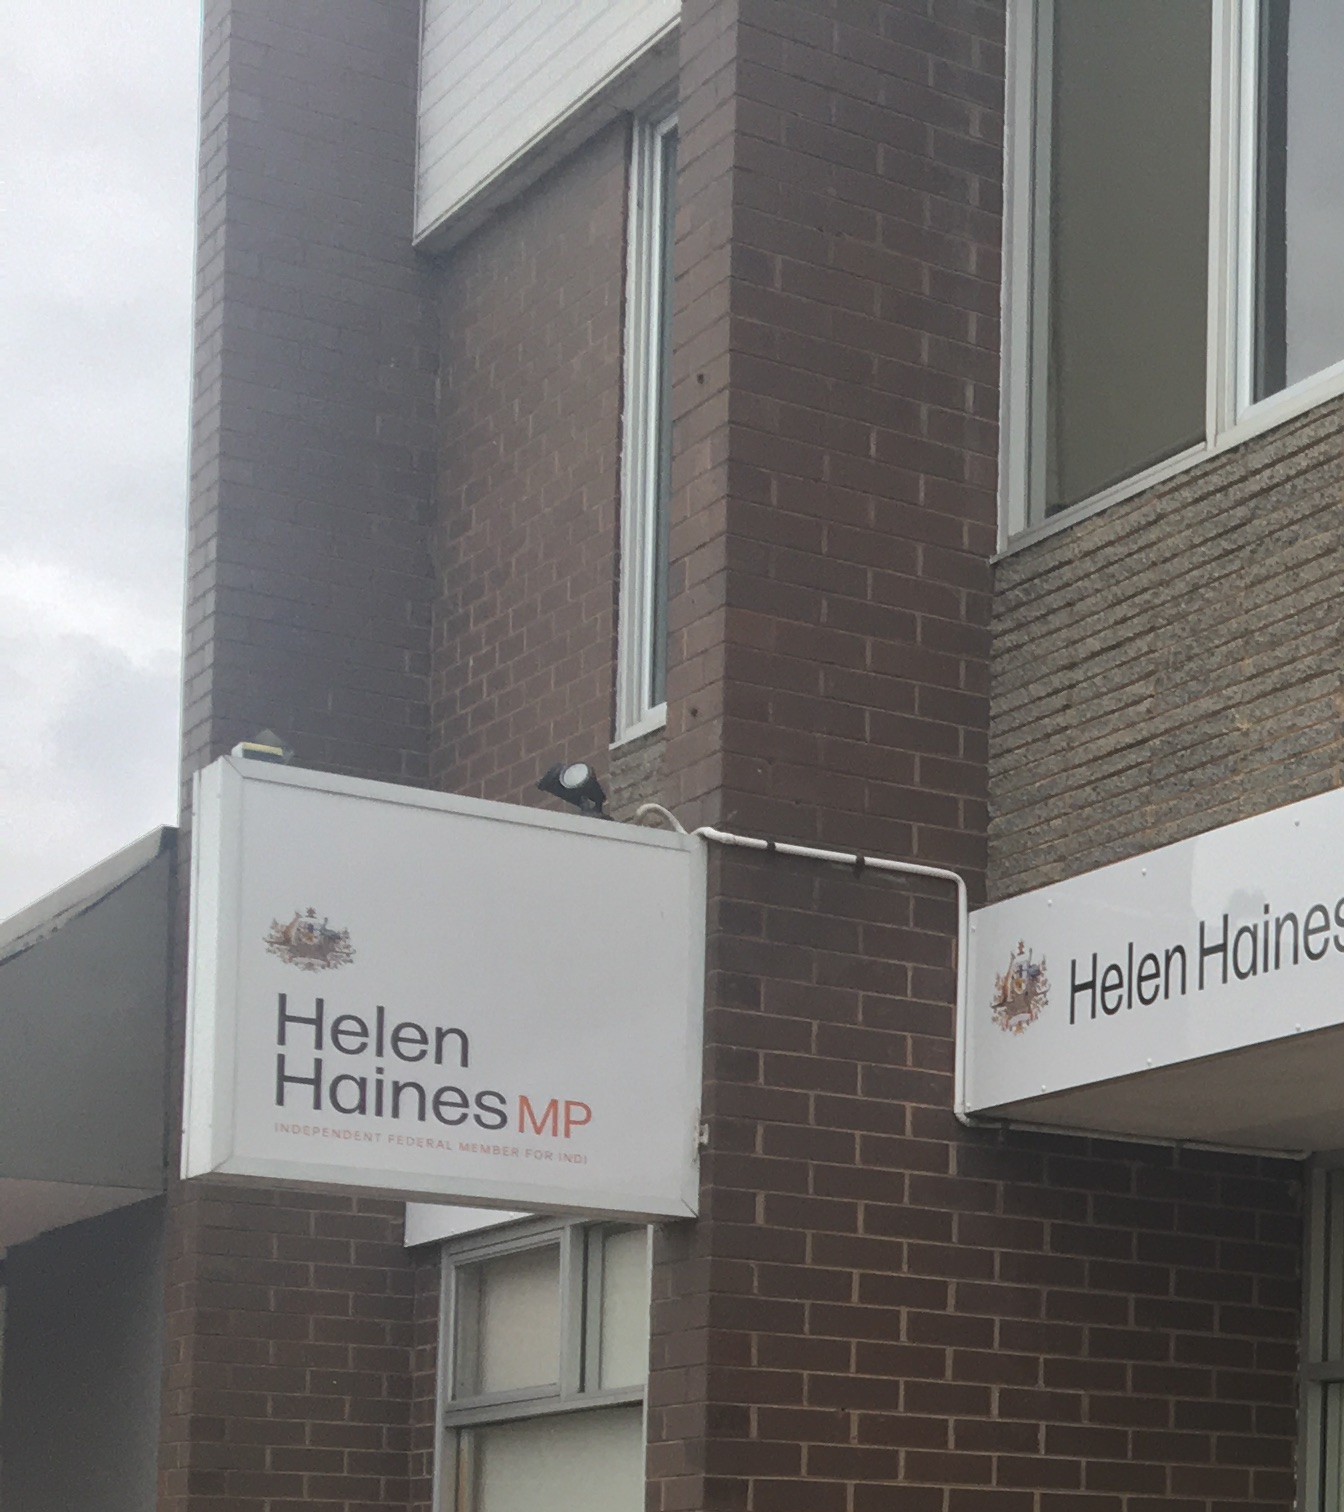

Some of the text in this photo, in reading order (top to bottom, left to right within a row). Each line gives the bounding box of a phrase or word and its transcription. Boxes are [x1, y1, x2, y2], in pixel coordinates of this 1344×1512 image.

[1070, 940, 1187, 1024] Helen
[276, 992, 470, 1068] Helen
[275, 1053, 593, 1140] Haines MP
[274, 1122, 588, 1165] INDEPENDENT FEDERAL MEMBER FOR INDI
